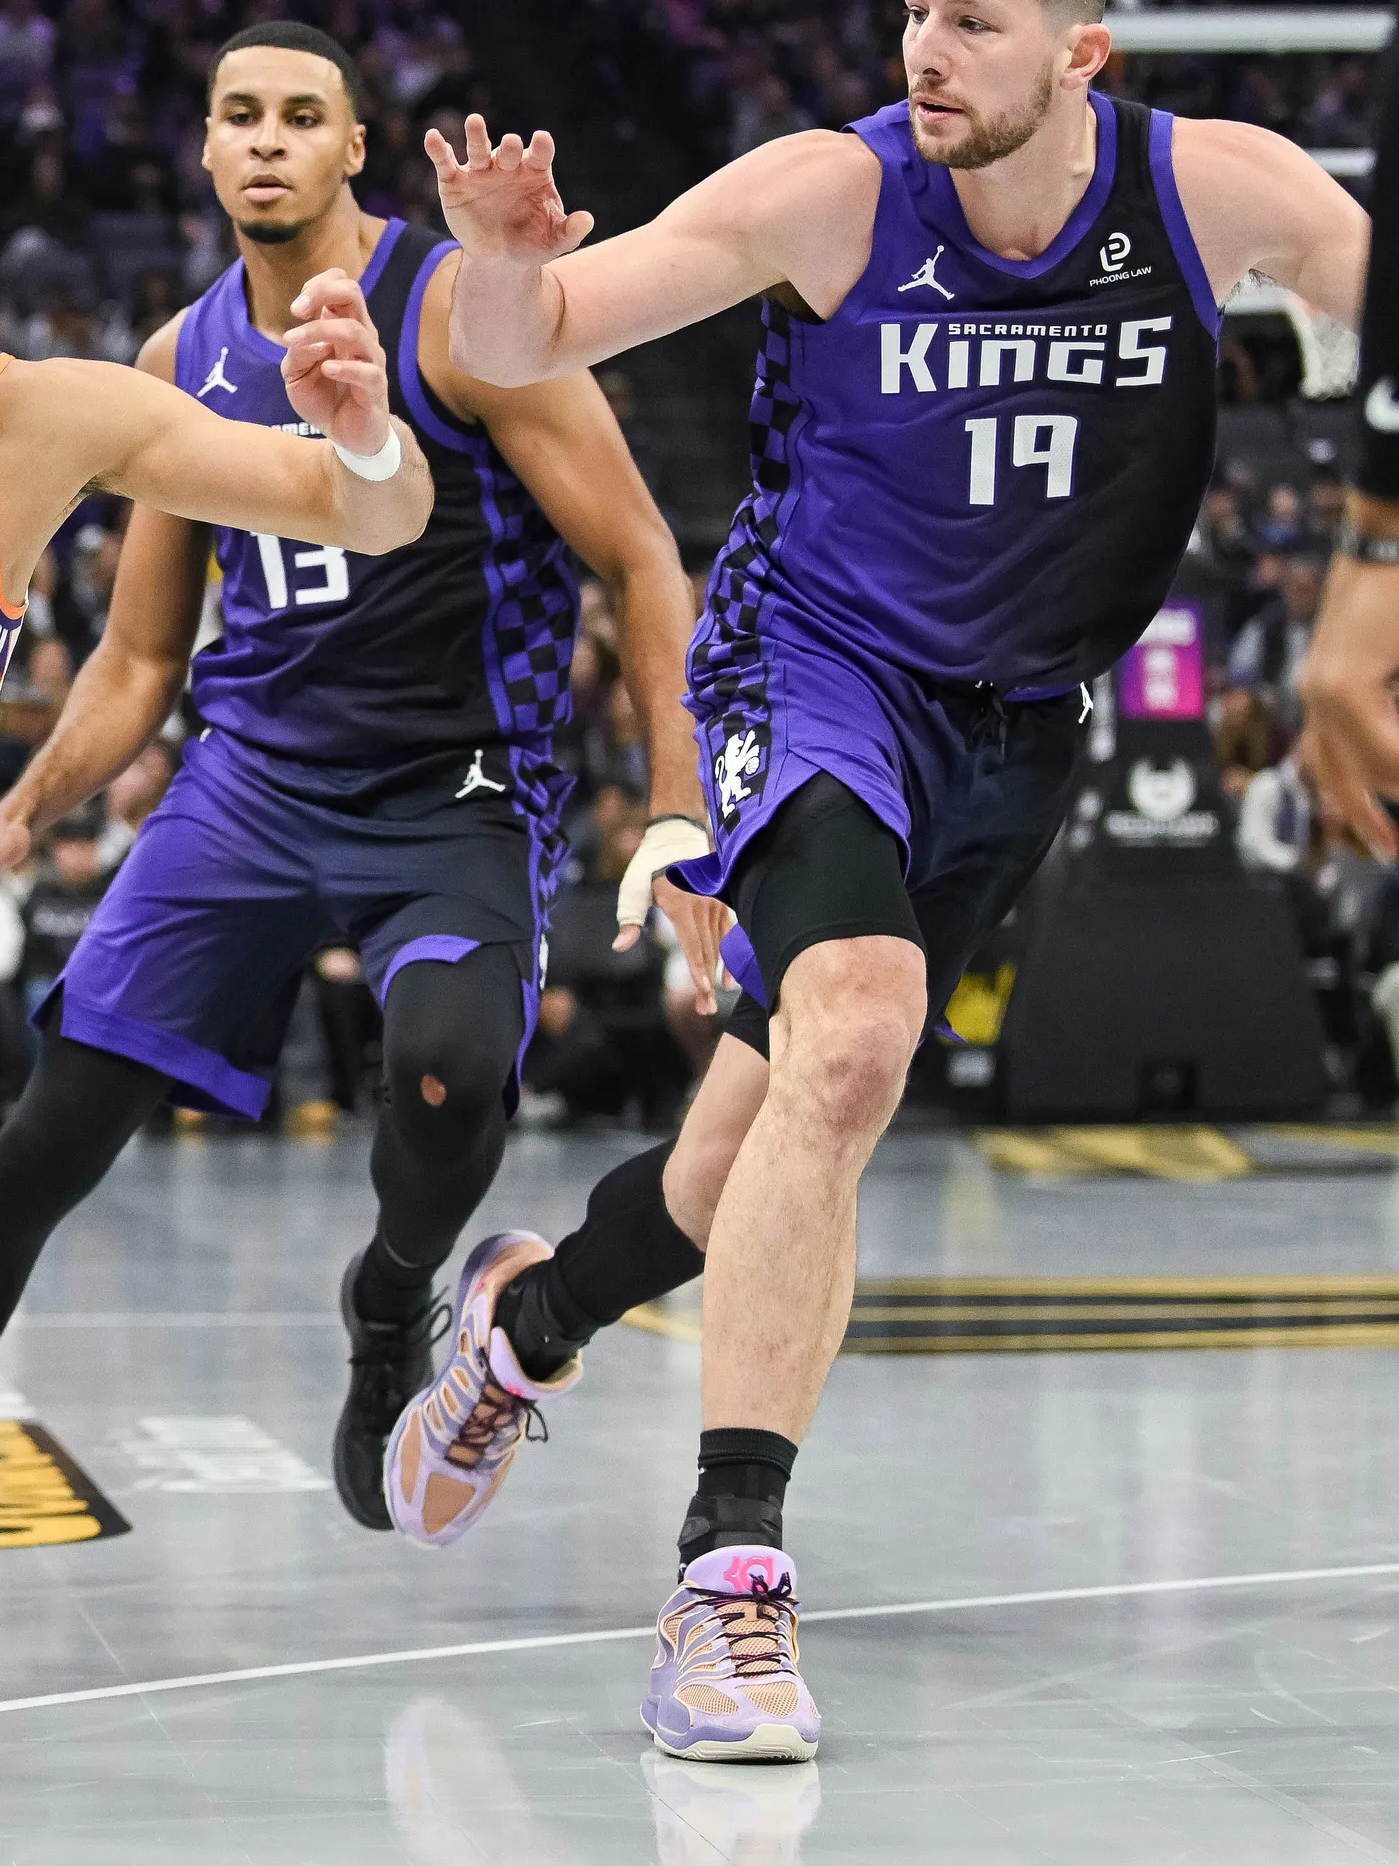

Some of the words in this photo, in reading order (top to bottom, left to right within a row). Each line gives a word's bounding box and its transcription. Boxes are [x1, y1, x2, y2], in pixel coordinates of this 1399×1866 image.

[1089, 271, 1130, 287] PHOONG
[1130, 266, 1152, 277] LAW
[880, 316, 1173, 394] KINGS
[948, 323, 1109, 337] SACRAMENTO
[964, 414, 1078, 506] 19
[250, 531, 350, 610] 13
